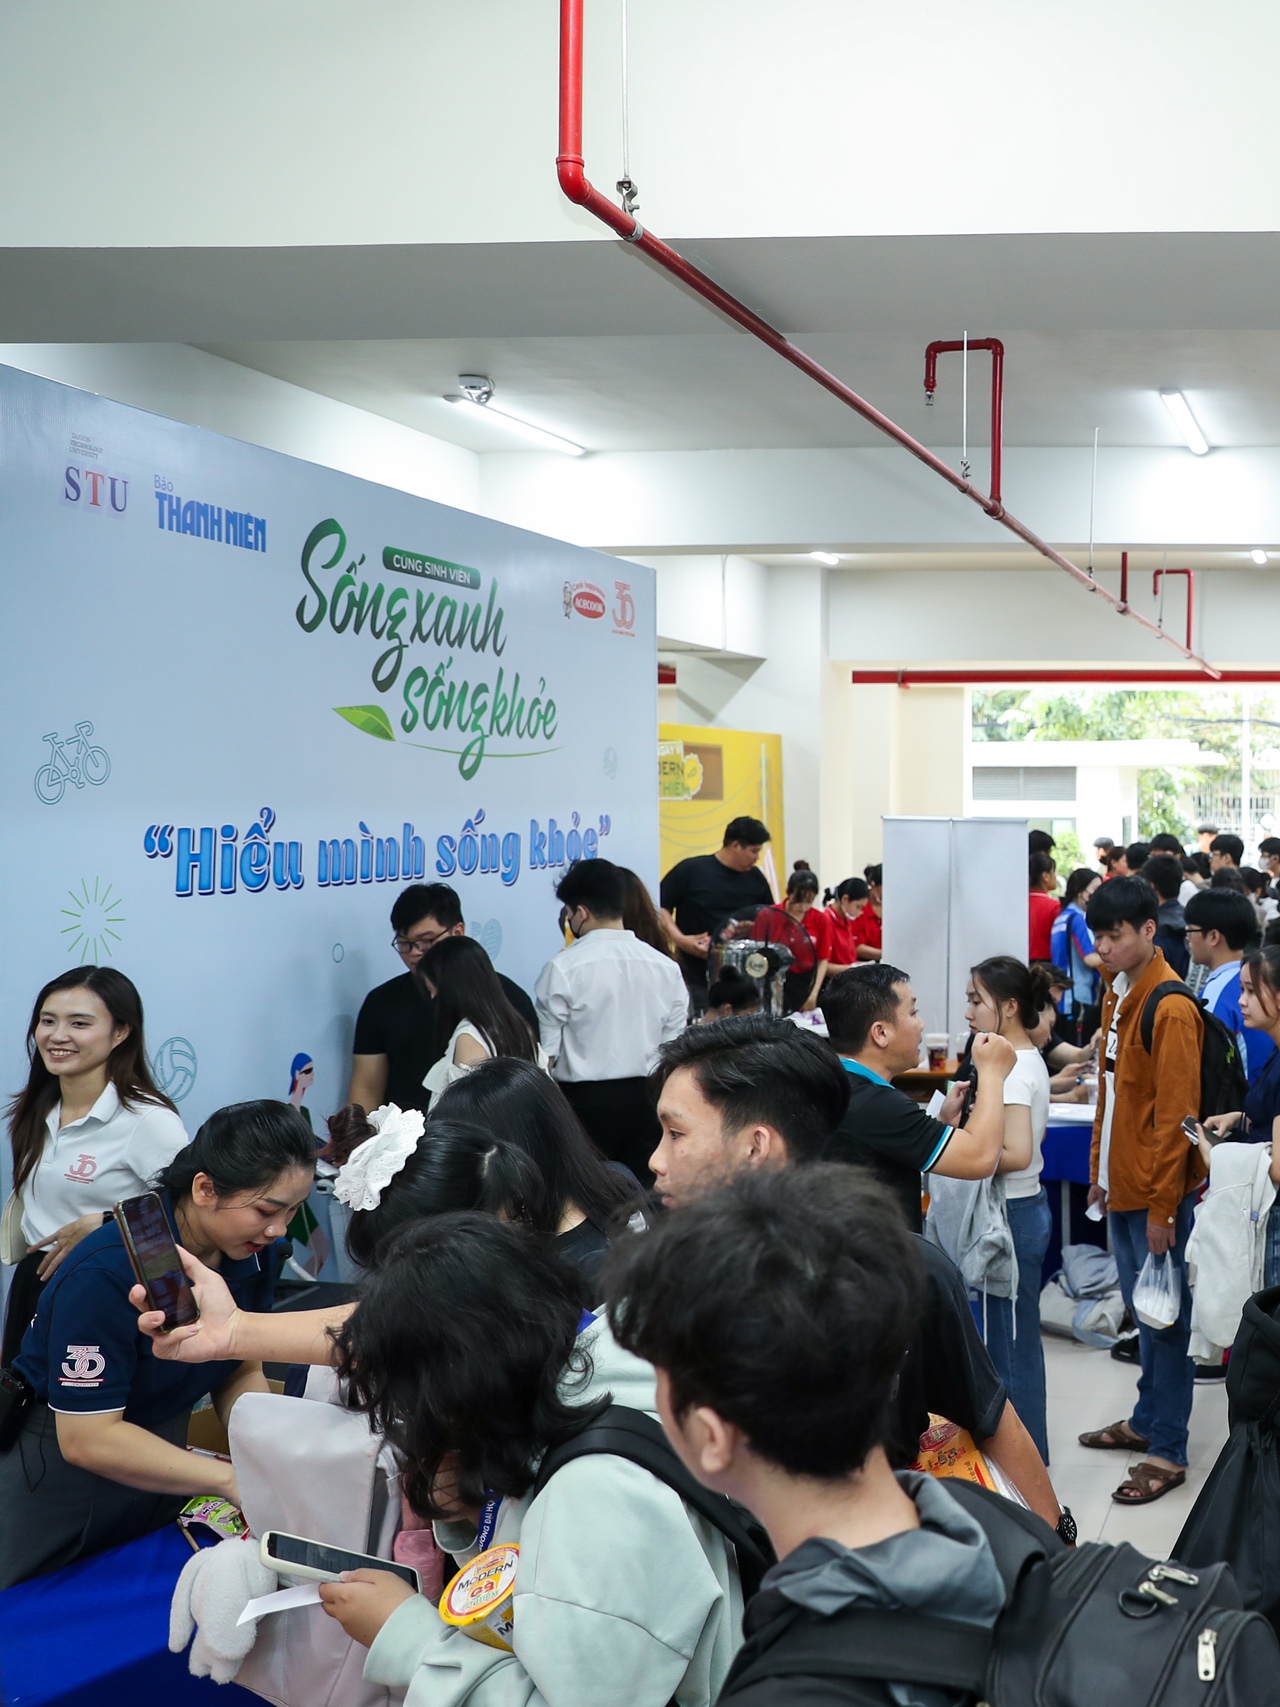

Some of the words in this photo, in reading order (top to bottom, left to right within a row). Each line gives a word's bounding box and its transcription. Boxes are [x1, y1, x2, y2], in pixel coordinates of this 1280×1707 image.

[65, 466, 129, 513] STU
[154, 474, 174, 493] Báo
[155, 491, 222, 543] THANH
[225, 509, 267, 553] NIÊN
[393, 553, 423, 573] CÙNG
[425, 561, 448, 579] SINH
[448, 567, 471, 585] VIÊN
[296, 518, 410, 693] Sống
[410, 577, 507, 657] xanh
[401, 656, 489, 781] sống
[489, 666, 558, 740] khỏe
[317, 820, 425, 886] mình
[435, 807, 522, 885] sống
[458, 1560, 514, 1591] MODERN
